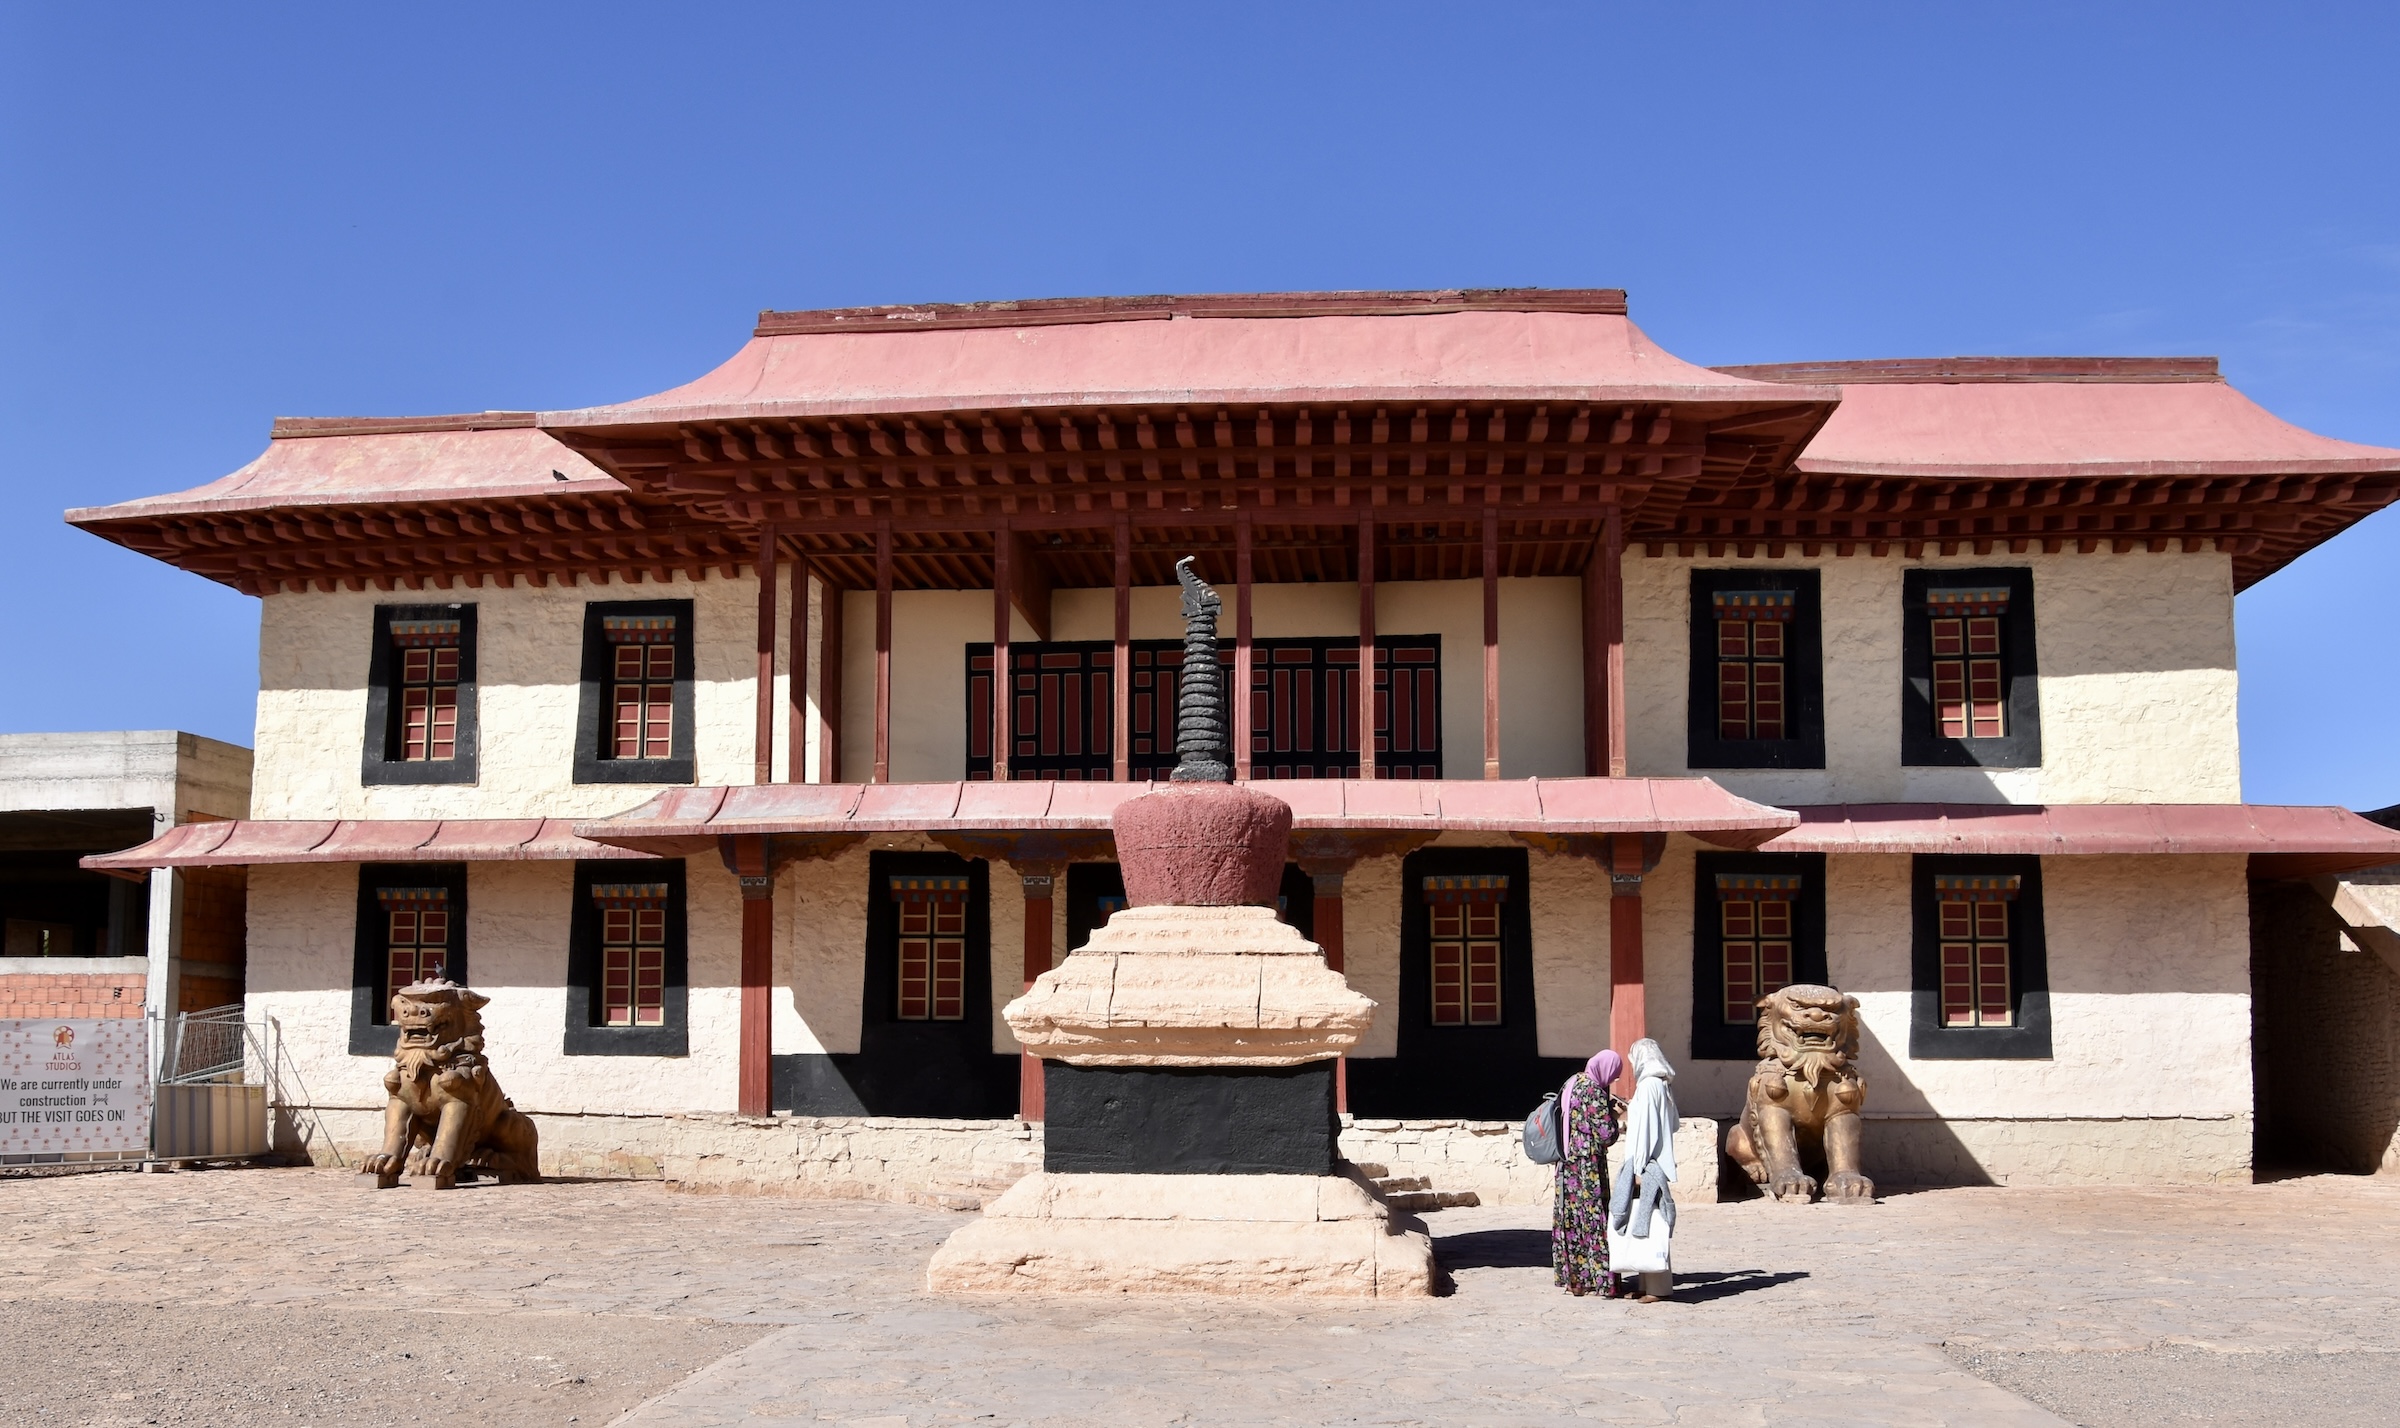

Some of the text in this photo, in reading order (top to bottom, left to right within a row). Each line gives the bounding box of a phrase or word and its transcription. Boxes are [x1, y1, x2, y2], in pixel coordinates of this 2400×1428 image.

[53, 1052, 74, 1061] ATLAS
[45, 1062, 81, 1071] STUDIOS
[0, 1077, 122, 1091] We are currently under
[19, 1095, 86, 1107] construction
[20, 1111, 41, 1123] THE
[44, 1110, 72, 1122] VISIT
[75, 1109, 104, 1122] GOES
[107, 1109, 126, 1121] ON!
